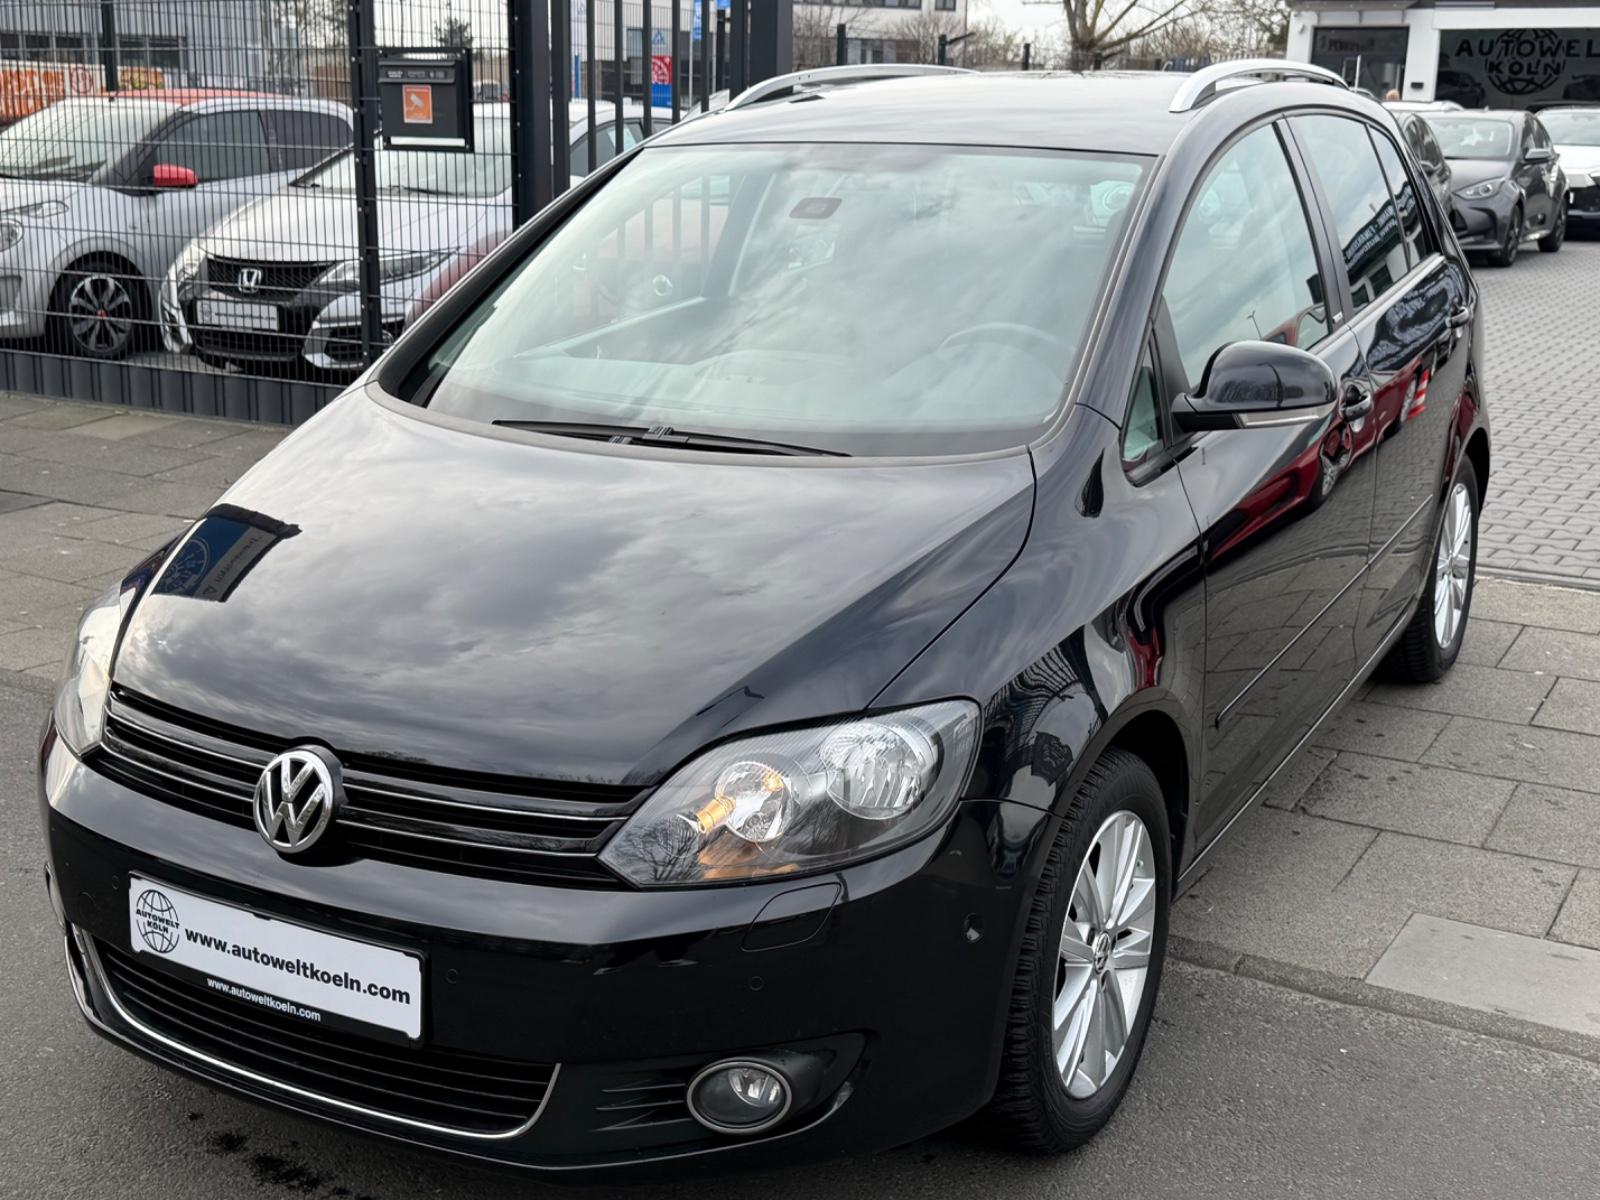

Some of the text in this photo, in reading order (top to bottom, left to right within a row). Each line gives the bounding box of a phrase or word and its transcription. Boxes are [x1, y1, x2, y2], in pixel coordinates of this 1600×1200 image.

[136, 909, 180, 929] AUTOWELT
[185, 926, 411, 1005] www.autoweltkoeln.com
[207, 976, 321, 1022] www.autoweltkoeln.com
